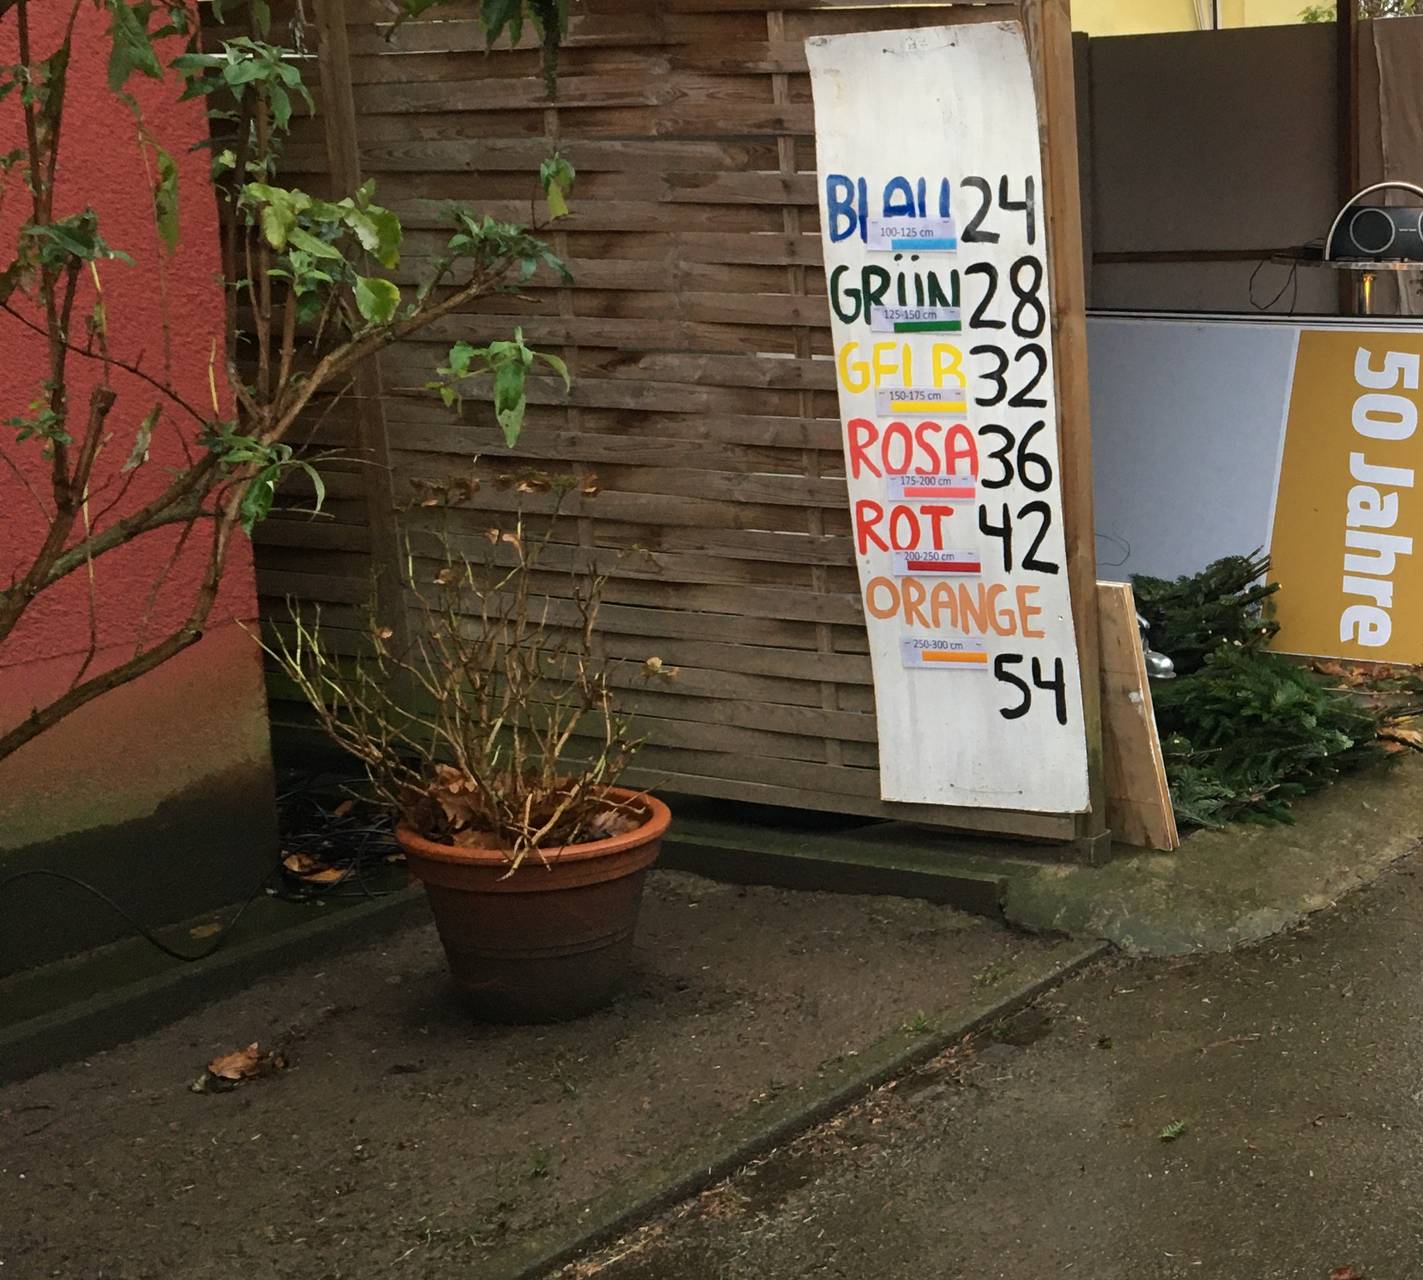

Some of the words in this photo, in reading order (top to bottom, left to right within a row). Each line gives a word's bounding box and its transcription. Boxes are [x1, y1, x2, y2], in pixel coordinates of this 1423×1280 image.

[880, 227, 917, 237] 100-125
[919, 229, 934, 237] cm
[960, 174, 1035, 245] 24
[830, 253, 960, 325] GRÜN
[964, 255, 1046, 339] 28
[884, 310, 921, 320] 125-150
[923, 311, 937, 320] cm
[890, 391, 926, 400] 150-175
[927, 392, 942, 400] cm
[969, 343, 1048, 408] 32
[1351, 346, 1421, 441] 50
[847, 418, 979, 480] ROSA
[978, 420, 1053, 492] 36
[900, 476, 936, 486] 175-200
[938, 478, 952, 486] cm
[855, 499, 954, 555] ROT
[978, 500, 1059, 574] 42
[904, 552, 939, 562] 200-250
[941, 553, 955, 562] cm
[1339, 452, 1415, 648] Jahre
[865, 576, 1045, 639] ORANGE
[912, 639, 948, 649] 250-300
[950, 640, 964, 650] cm
[993, 653, 1067, 725] 54
